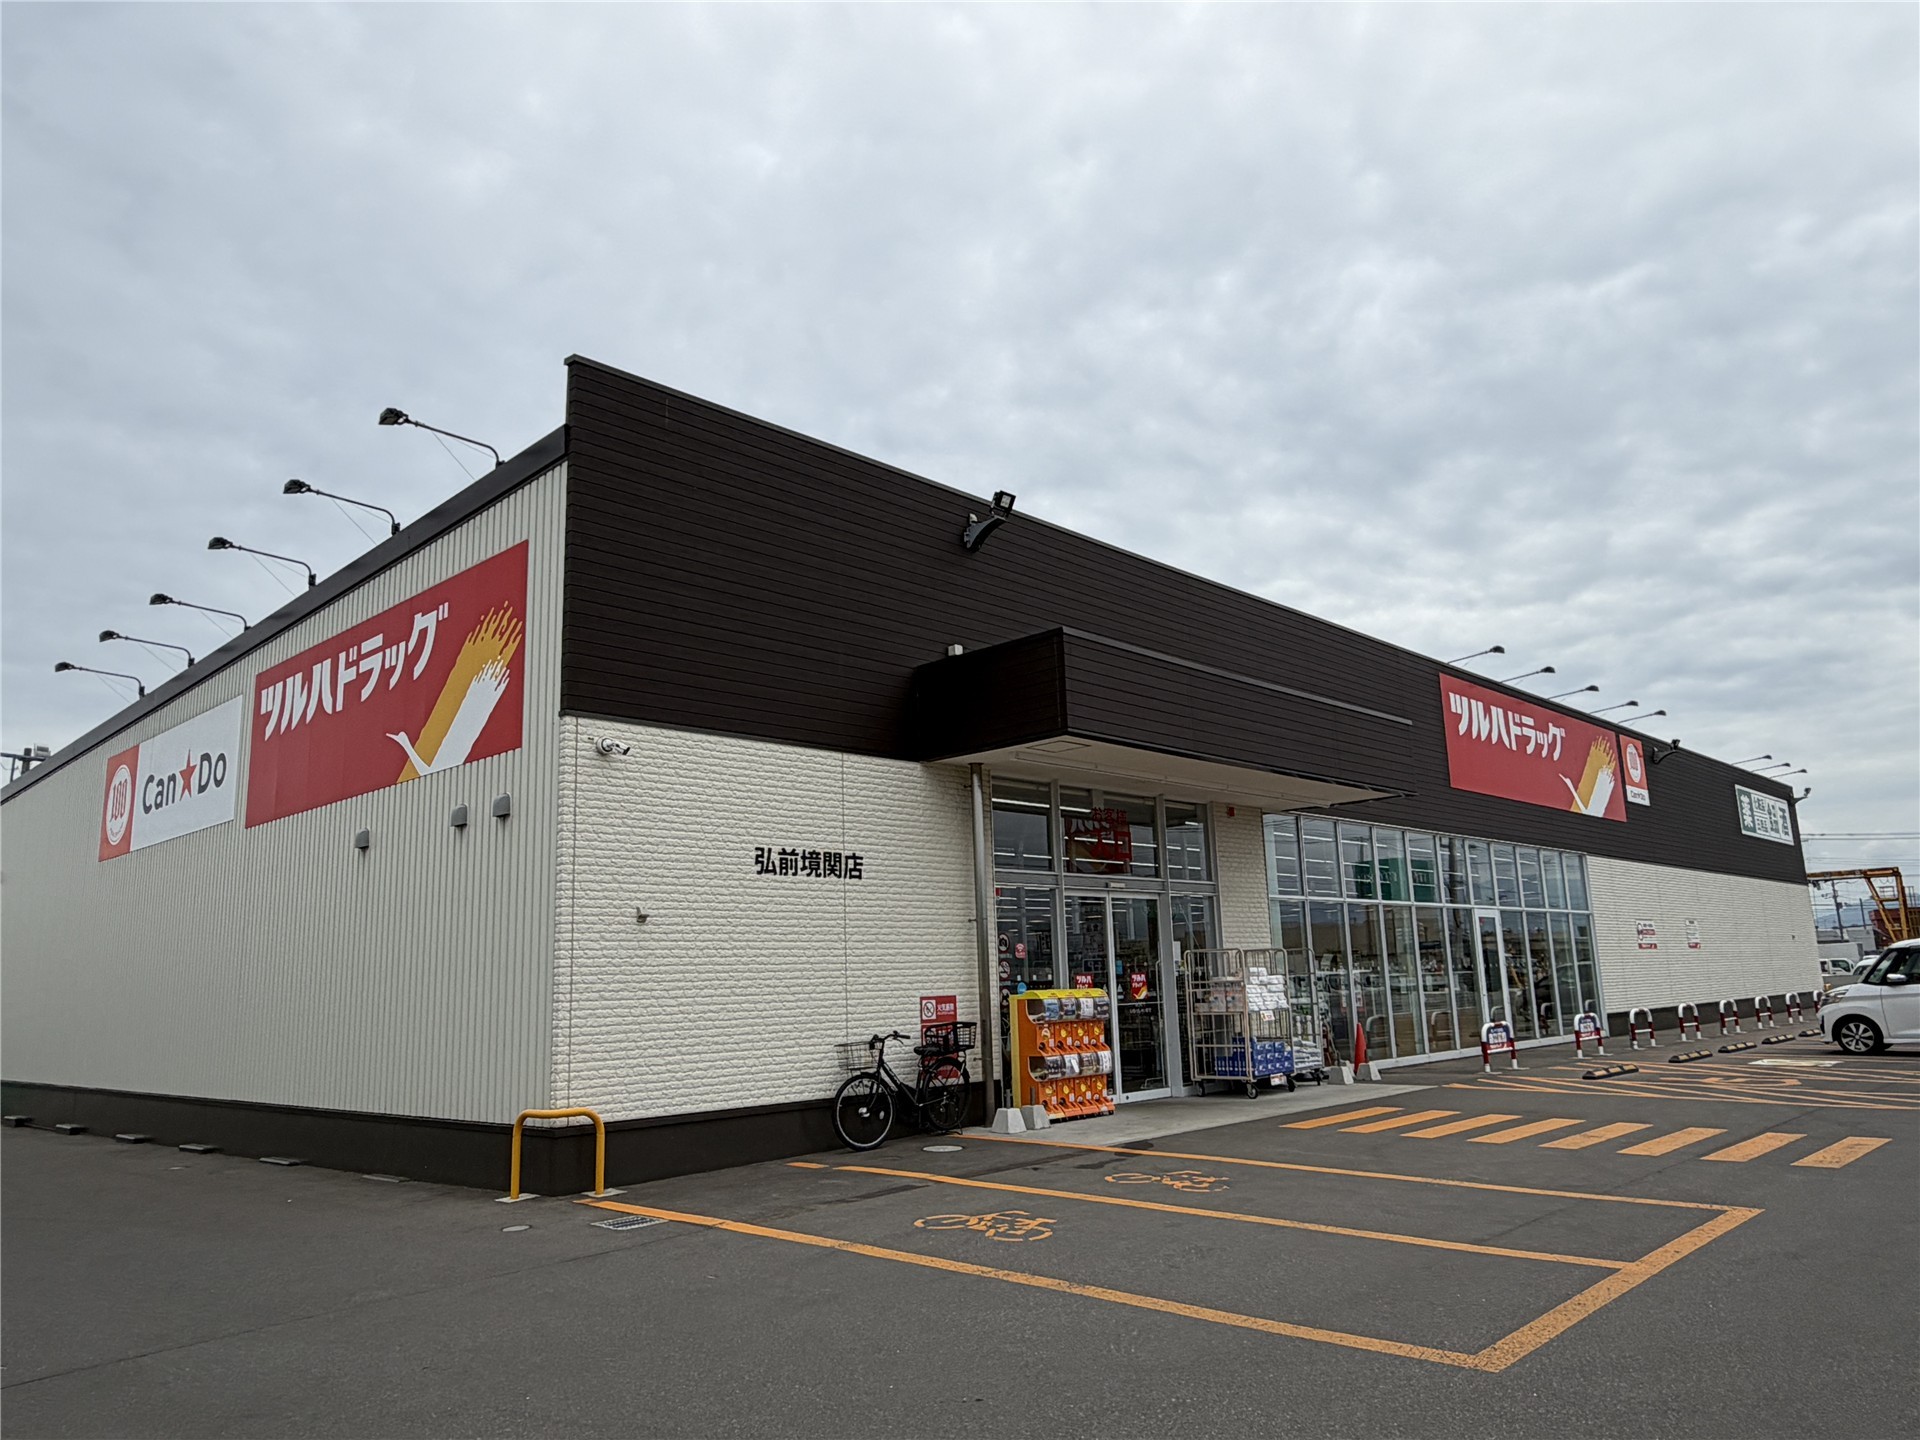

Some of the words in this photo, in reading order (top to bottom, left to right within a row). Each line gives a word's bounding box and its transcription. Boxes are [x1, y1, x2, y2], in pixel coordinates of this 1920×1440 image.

[260, 602, 448, 741] ツルハドラッグ
[1449, 692, 1565, 761] ツルハドラッグ
[755, 847, 863, 880] 弘前境関店
